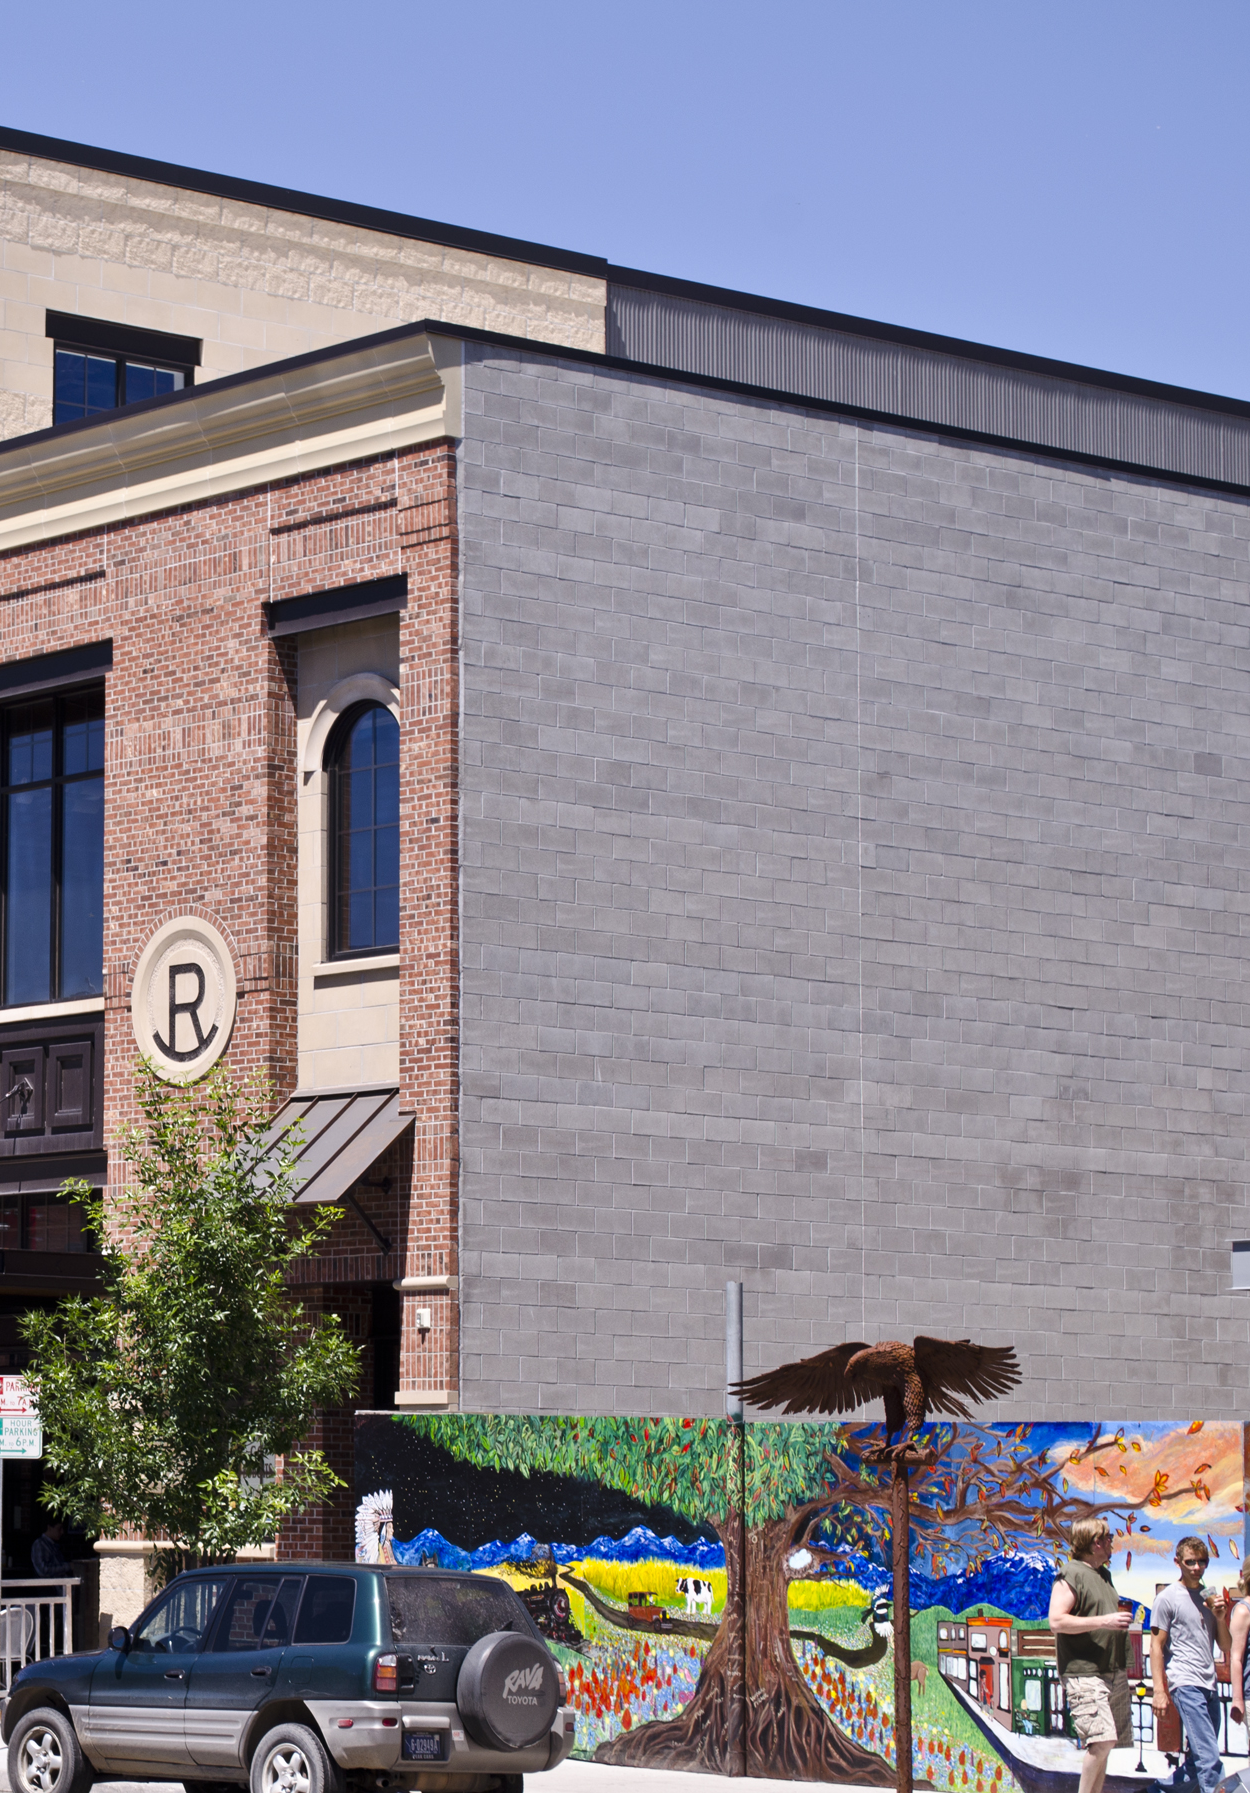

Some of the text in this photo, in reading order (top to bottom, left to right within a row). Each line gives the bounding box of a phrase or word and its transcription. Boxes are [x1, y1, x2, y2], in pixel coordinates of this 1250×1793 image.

[152, 962, 219, 1063] R
[10, 1419, 32, 1427] HOUR
[4, 1427, 38, 1436] PARKING
[507, 1695, 538, 1706] TOYOTA
